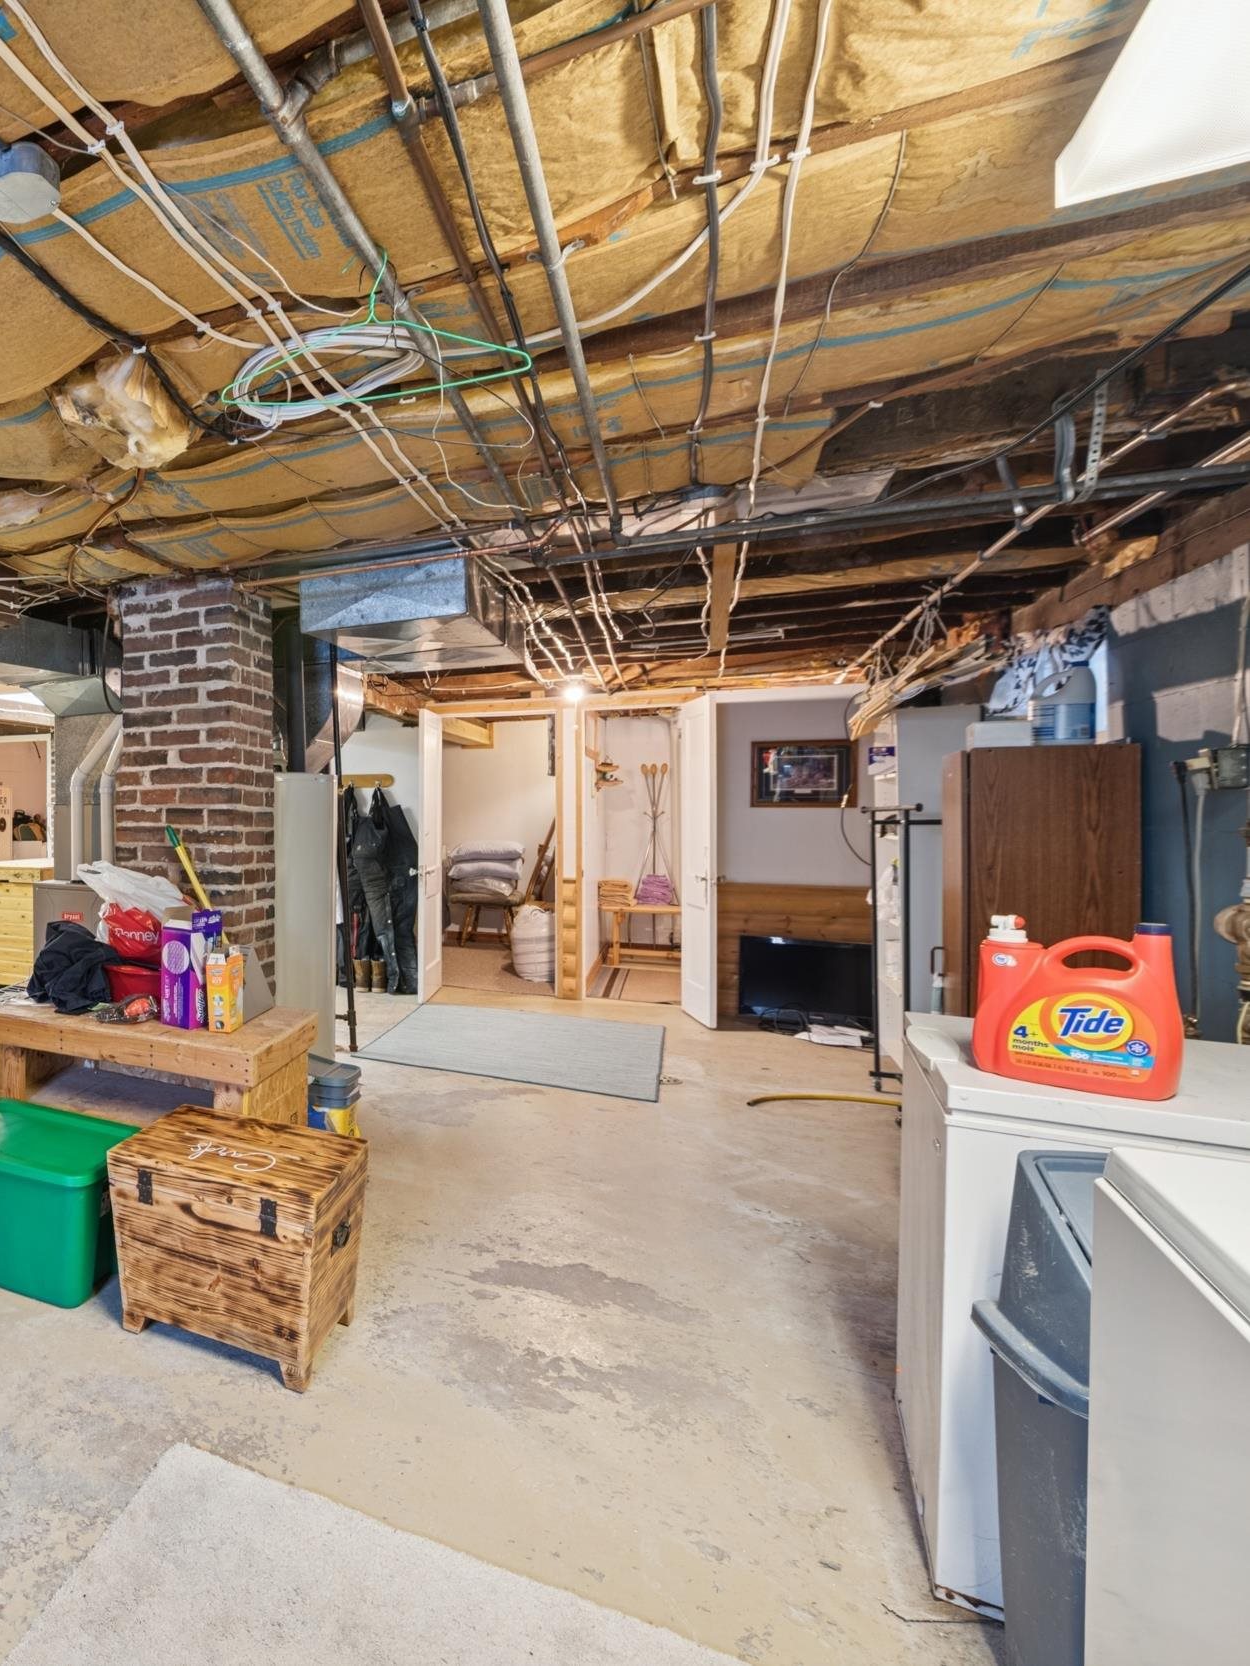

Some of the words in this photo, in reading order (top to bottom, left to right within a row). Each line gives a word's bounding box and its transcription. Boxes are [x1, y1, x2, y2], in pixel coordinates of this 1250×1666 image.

[1059, 1006, 1125, 1037] Tide
[1012, 1038, 1049, 1048] months
[1012, 1044, 1035, 1052] mois
